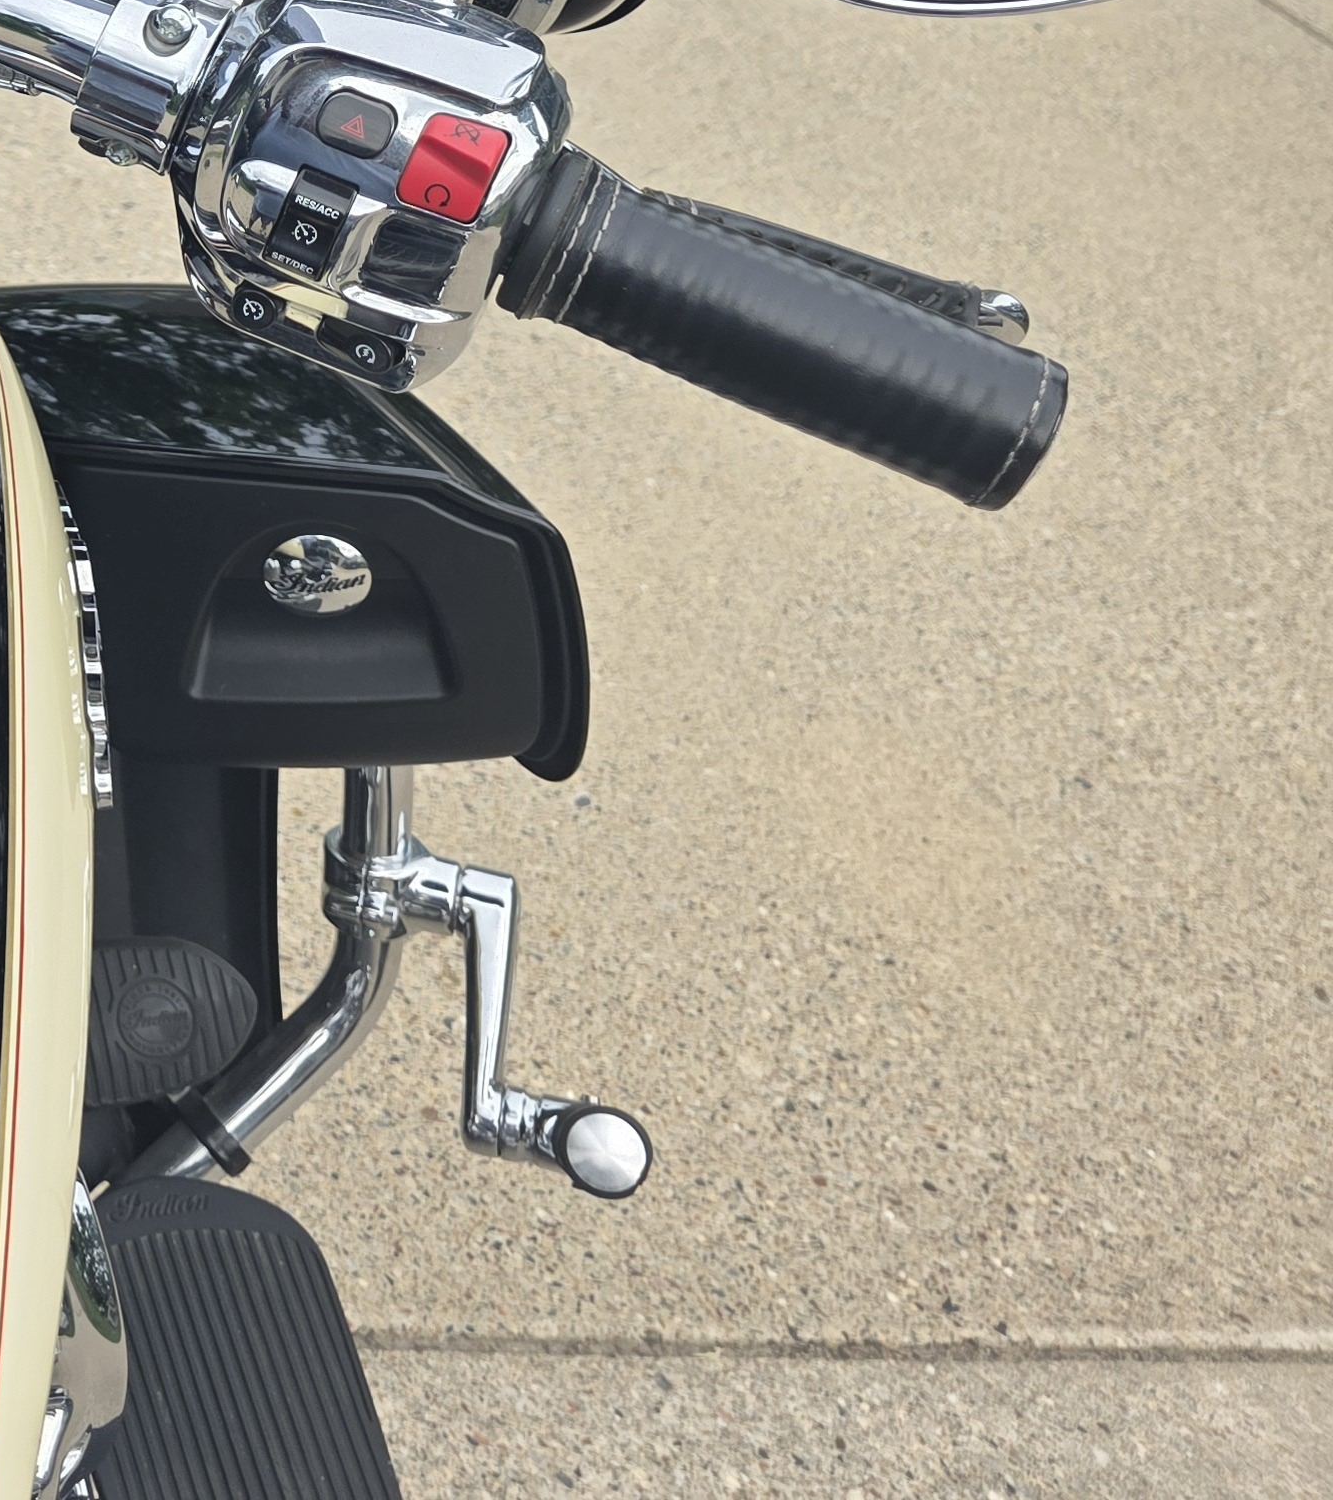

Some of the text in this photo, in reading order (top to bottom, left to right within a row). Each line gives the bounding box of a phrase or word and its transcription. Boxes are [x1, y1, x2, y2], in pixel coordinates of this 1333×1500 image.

[294, 194, 340, 220] RES/ACC
[271, 251, 314, 275] SET/DEC
[273, 573, 366, 596] Indian
[106, 1191, 209, 1222] Indian
